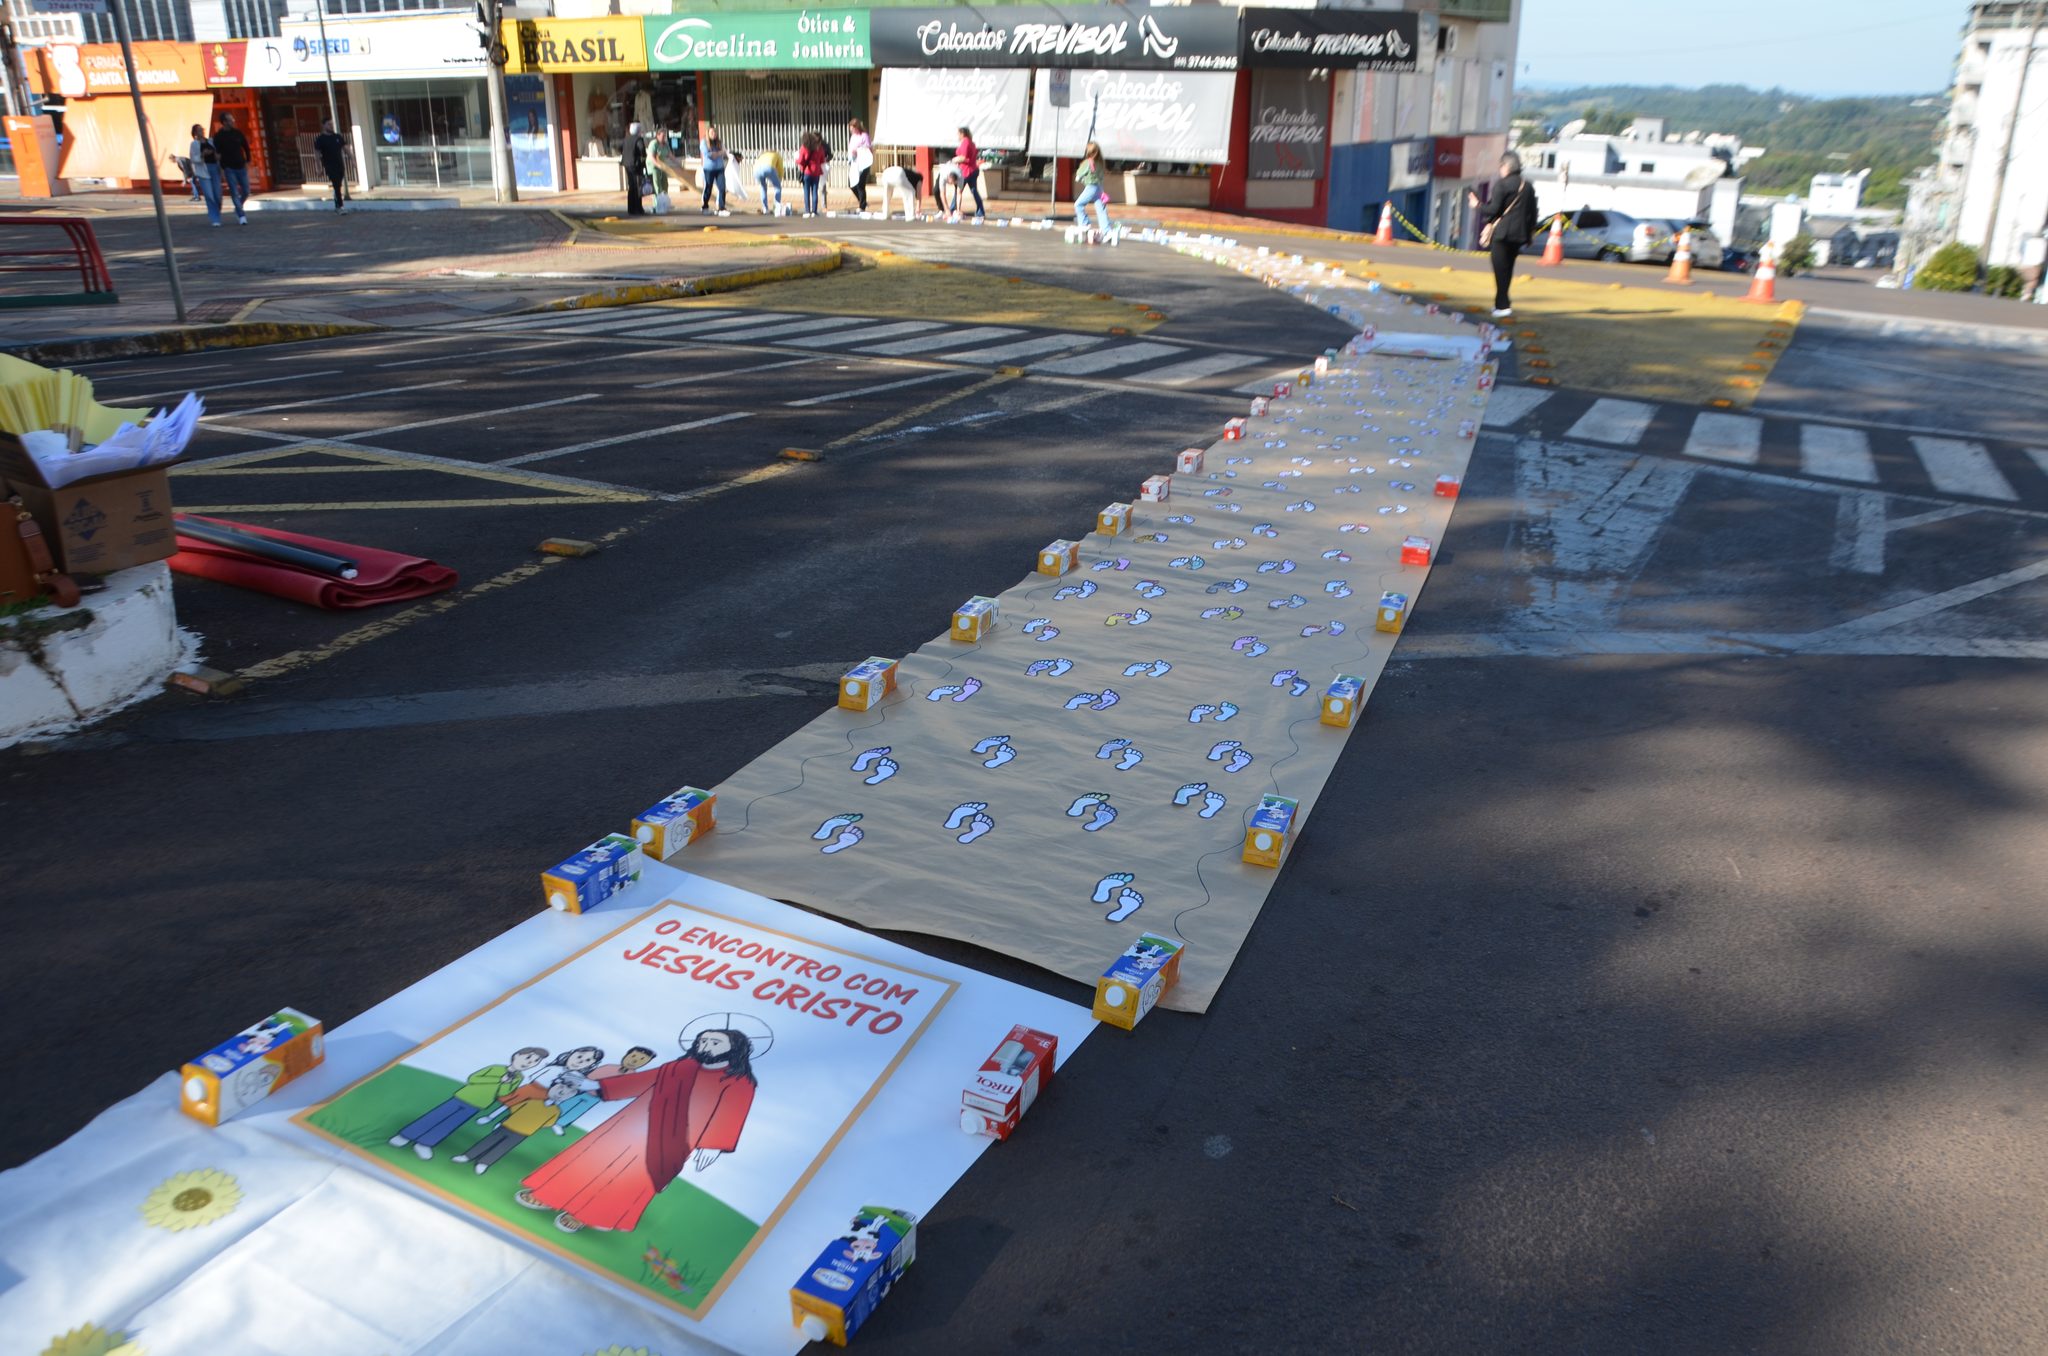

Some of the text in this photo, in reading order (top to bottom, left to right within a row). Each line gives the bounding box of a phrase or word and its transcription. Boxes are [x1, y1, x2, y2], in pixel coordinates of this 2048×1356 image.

[797, 11, 856, 34] Ótica &
[792, 38, 864, 60] Joalheria
[917, 20, 1129, 55] Calçados TREVISOL
[1312, 33, 1385, 56] TREVISOL
[524, 38, 624, 63] BRASIL
[88, 71, 120, 86] SANTA
[1249, 125, 1325, 144] TREVISOL
[654, 918, 919, 1006] O ENCONTRO COM
[623, 942, 904, 1036] JESUS CRISTO
[975, 1074, 1015, 1095] TIROL
